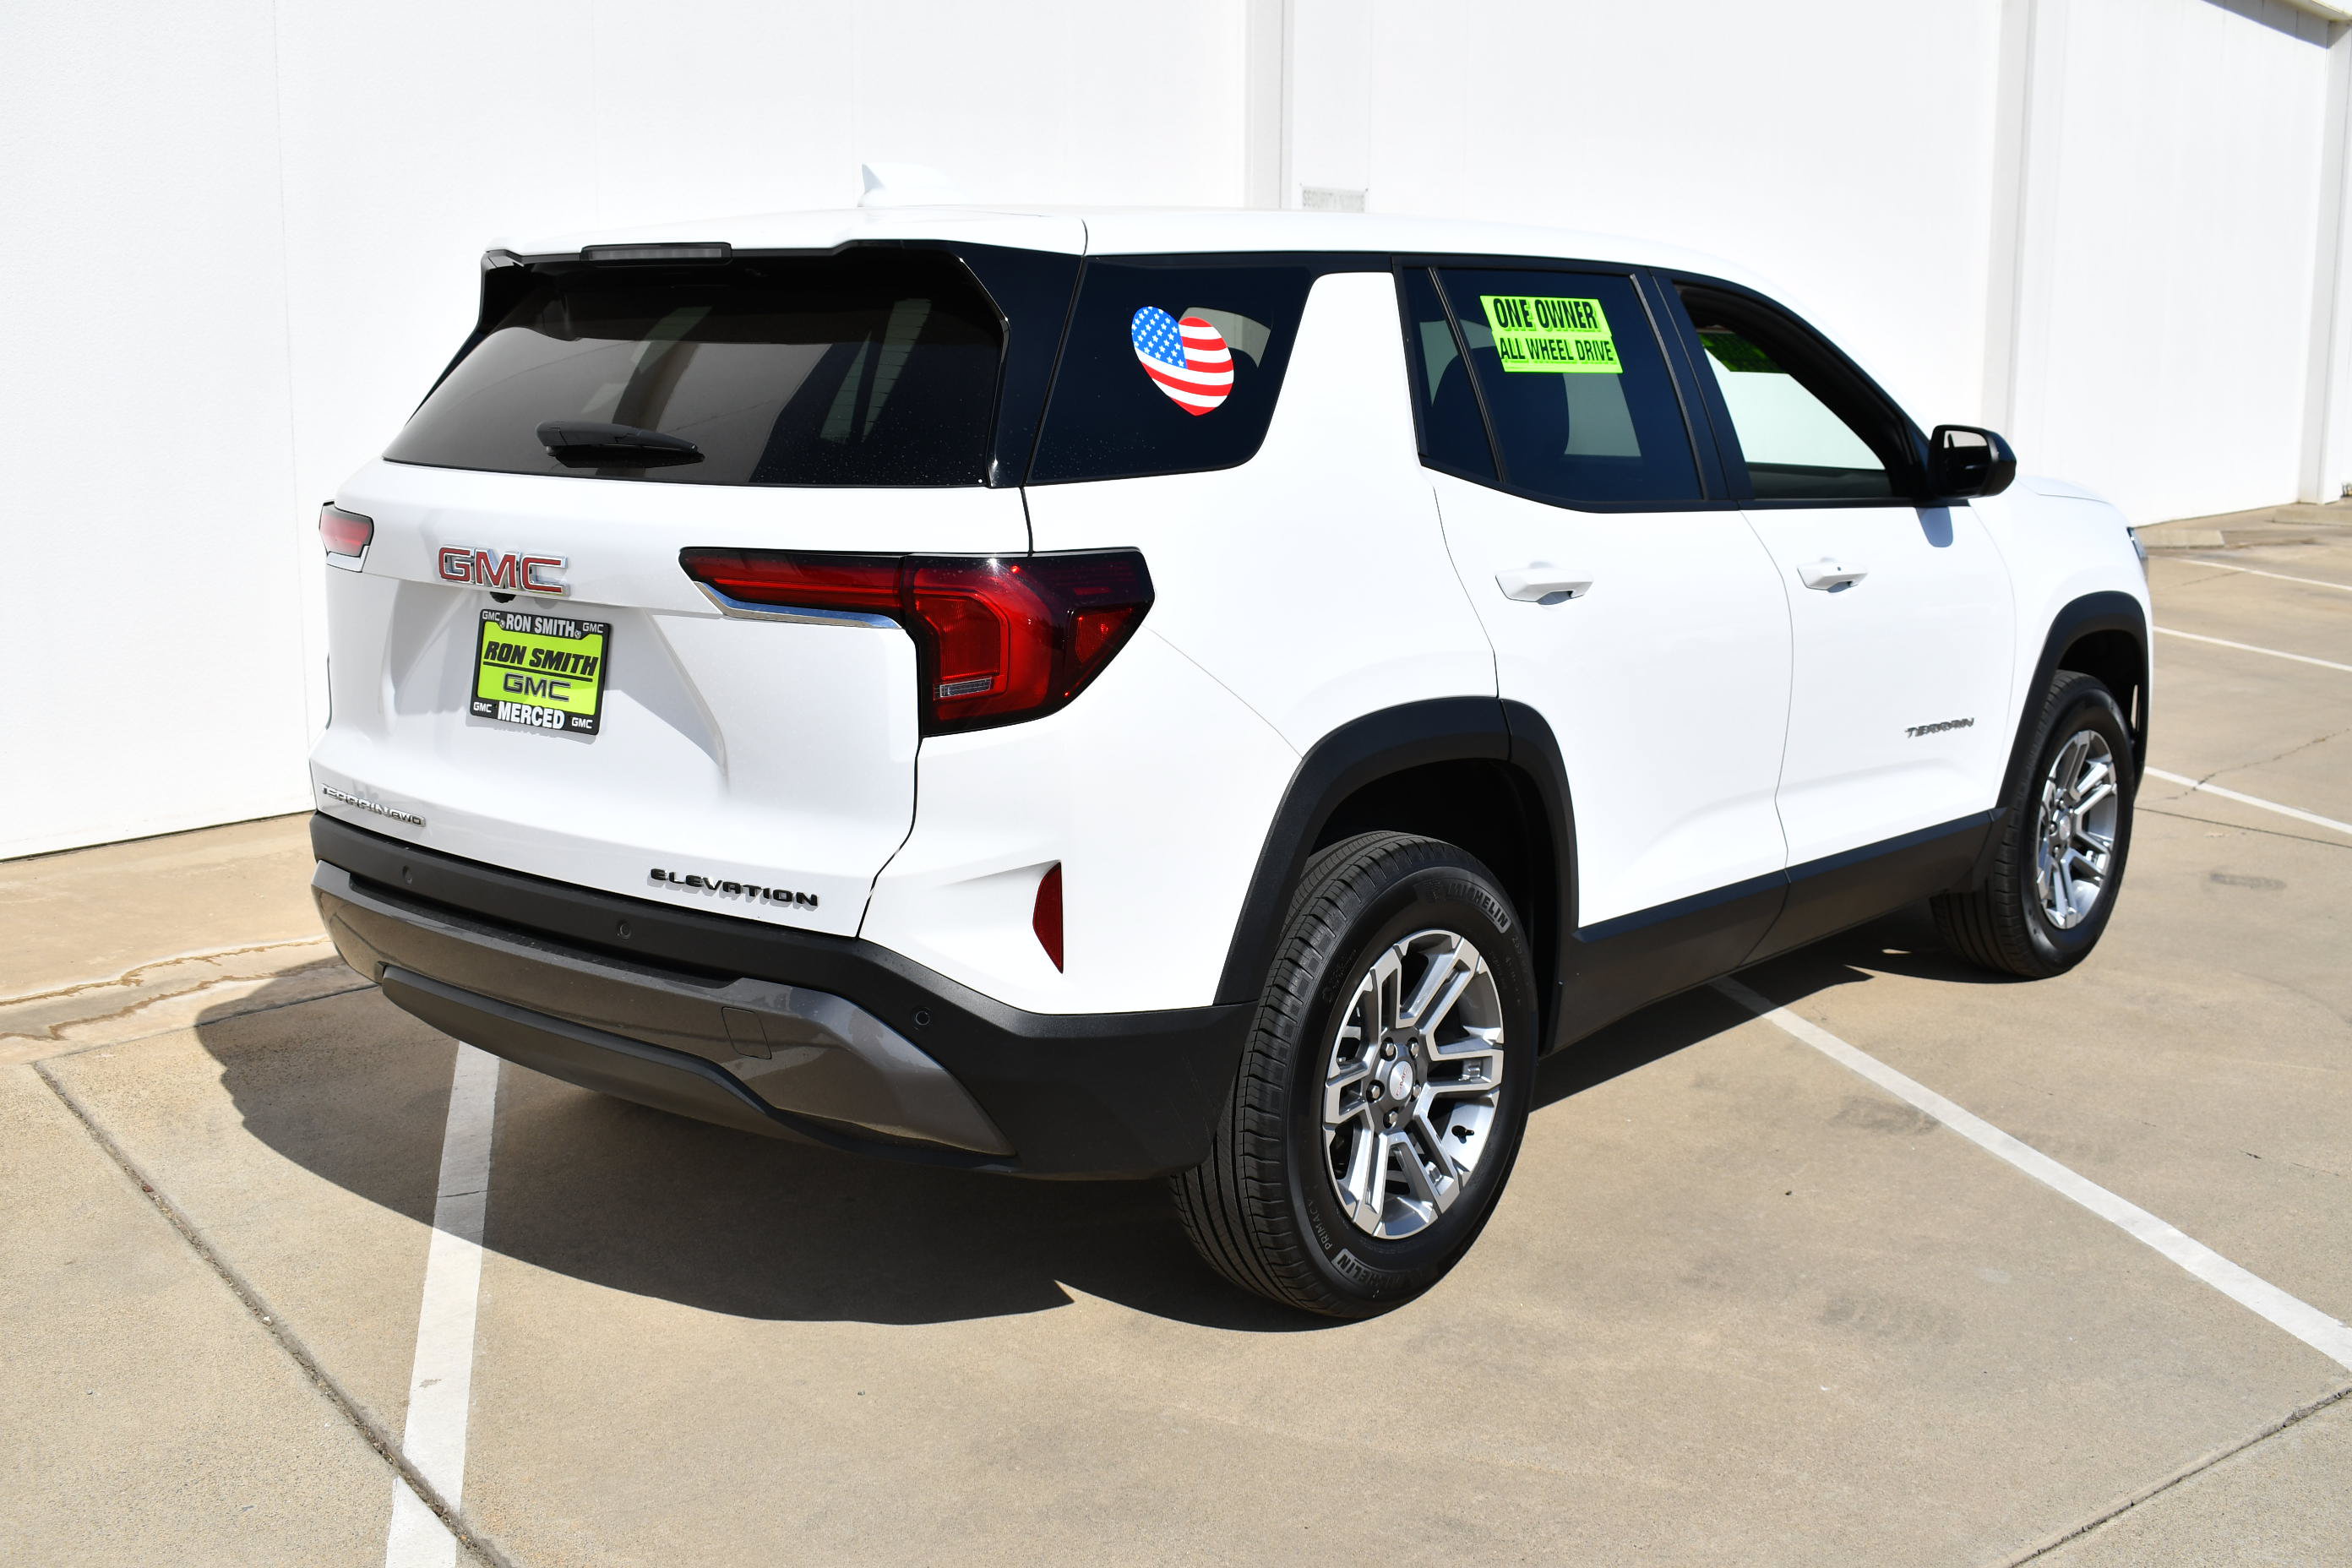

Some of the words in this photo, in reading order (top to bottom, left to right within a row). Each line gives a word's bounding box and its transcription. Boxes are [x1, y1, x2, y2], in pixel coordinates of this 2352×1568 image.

[1493, 298, 1534, 329] ONE
[1534, 299, 1599, 330] OWNER
[1500, 338, 1526, 360] ALL
[1526, 338, 1575, 361] WHEEL
[1575, 340, 1614, 362] DRIVE
[438, 546, 569, 596] GMC
[482, 611, 500, 621] GMC
[506, 613, 531, 633] RON
[535, 617, 575, 638] SMITH
[582, 622, 604, 634] GMC
[484, 640, 527, 665] RON
[529, 647, 599, 677] SMITH
[503, 672, 571, 702] GMC
[473, 701, 493, 713] GMC
[497, 700, 565, 730] MERCED
[571, 716, 593, 729] GMC
[1904, 717, 1974, 738] TERRAIN
[650, 868, 819, 906] ELEVATION
[1447, 883, 1509, 928] MICHELIN
[1309, 1200, 1333, 1250] PRIMACY
